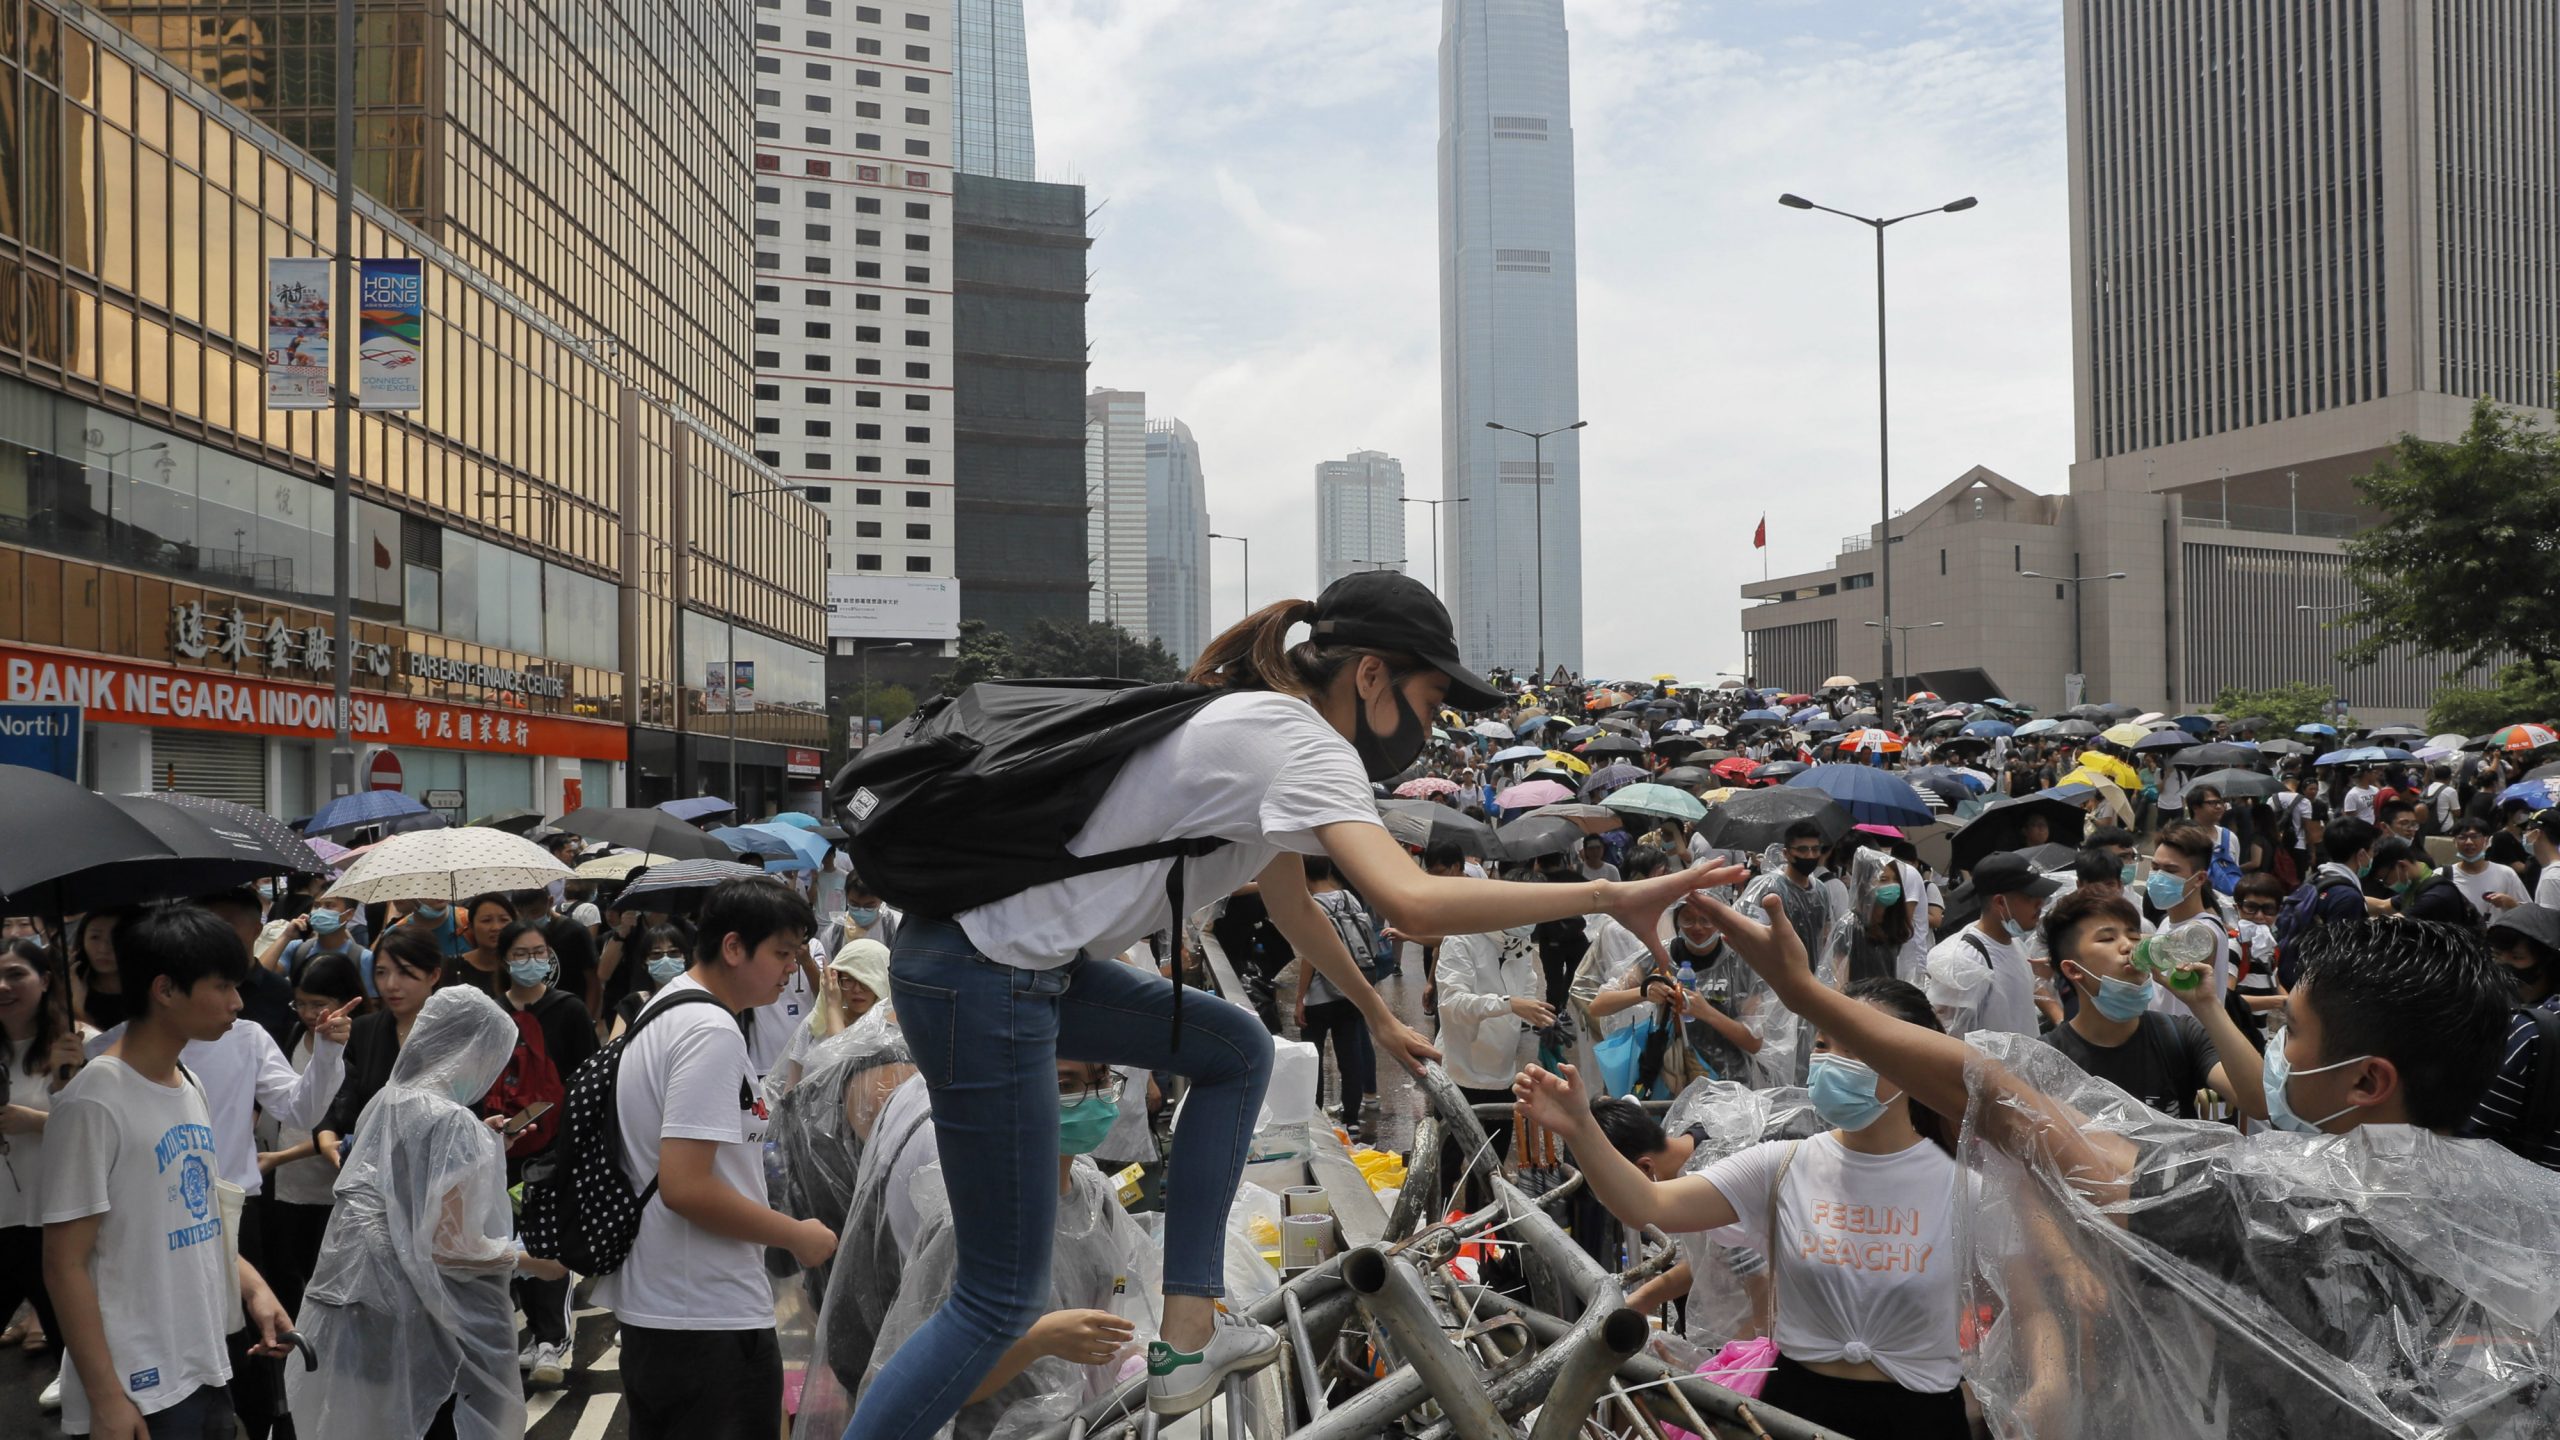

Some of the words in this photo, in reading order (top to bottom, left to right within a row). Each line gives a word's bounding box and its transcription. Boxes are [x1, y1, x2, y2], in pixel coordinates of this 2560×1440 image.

[364, 277, 417, 289] HONG
[364, 290, 417, 303] KONG
[362, 377, 411, 385] CONNECT
[411, 653, 438, 677] FAR
[440, 659, 475, 684] EAST
[477, 664, 525, 692] FINANCE
[527, 673, 565, 698] CENTRE
[8, 658, 117, 711] BANK
[124, 672, 256, 723] NEGARA
[259, 689, 390, 735] INDONSIA
[415, 707, 529, 748] 印尼國家銀行
[1810, 1199, 1919, 1236] FEELIN
[1799, 1229, 1933, 1273] PEACHY
